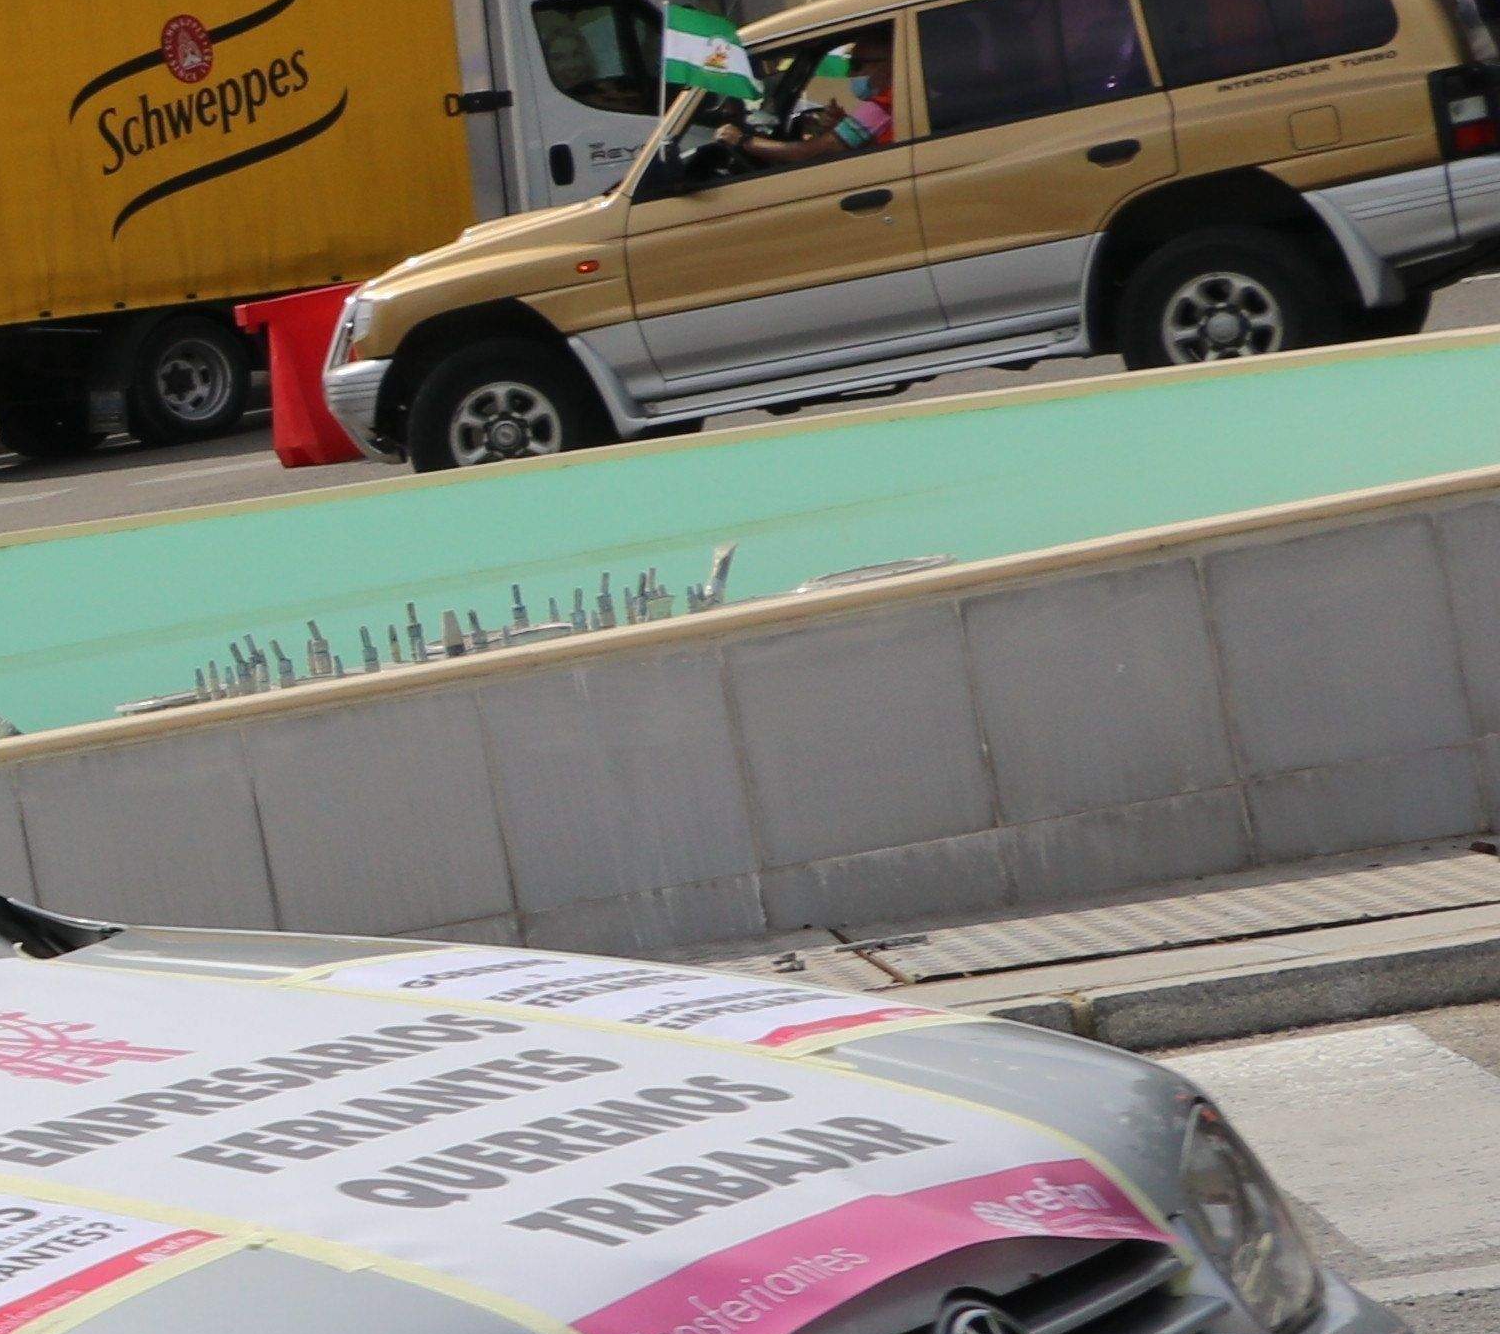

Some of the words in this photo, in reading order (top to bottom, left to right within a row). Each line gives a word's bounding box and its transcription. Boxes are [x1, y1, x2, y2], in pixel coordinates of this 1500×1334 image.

[98, 49, 310, 176] Schweppes
[1340, 51, 1398, 67] TURBO
[176, 1049, 623, 1176] FERIANTES
[335, 1073, 796, 1209] QUEREMOS
[503, 1113, 957, 1249] TRABAJAR
